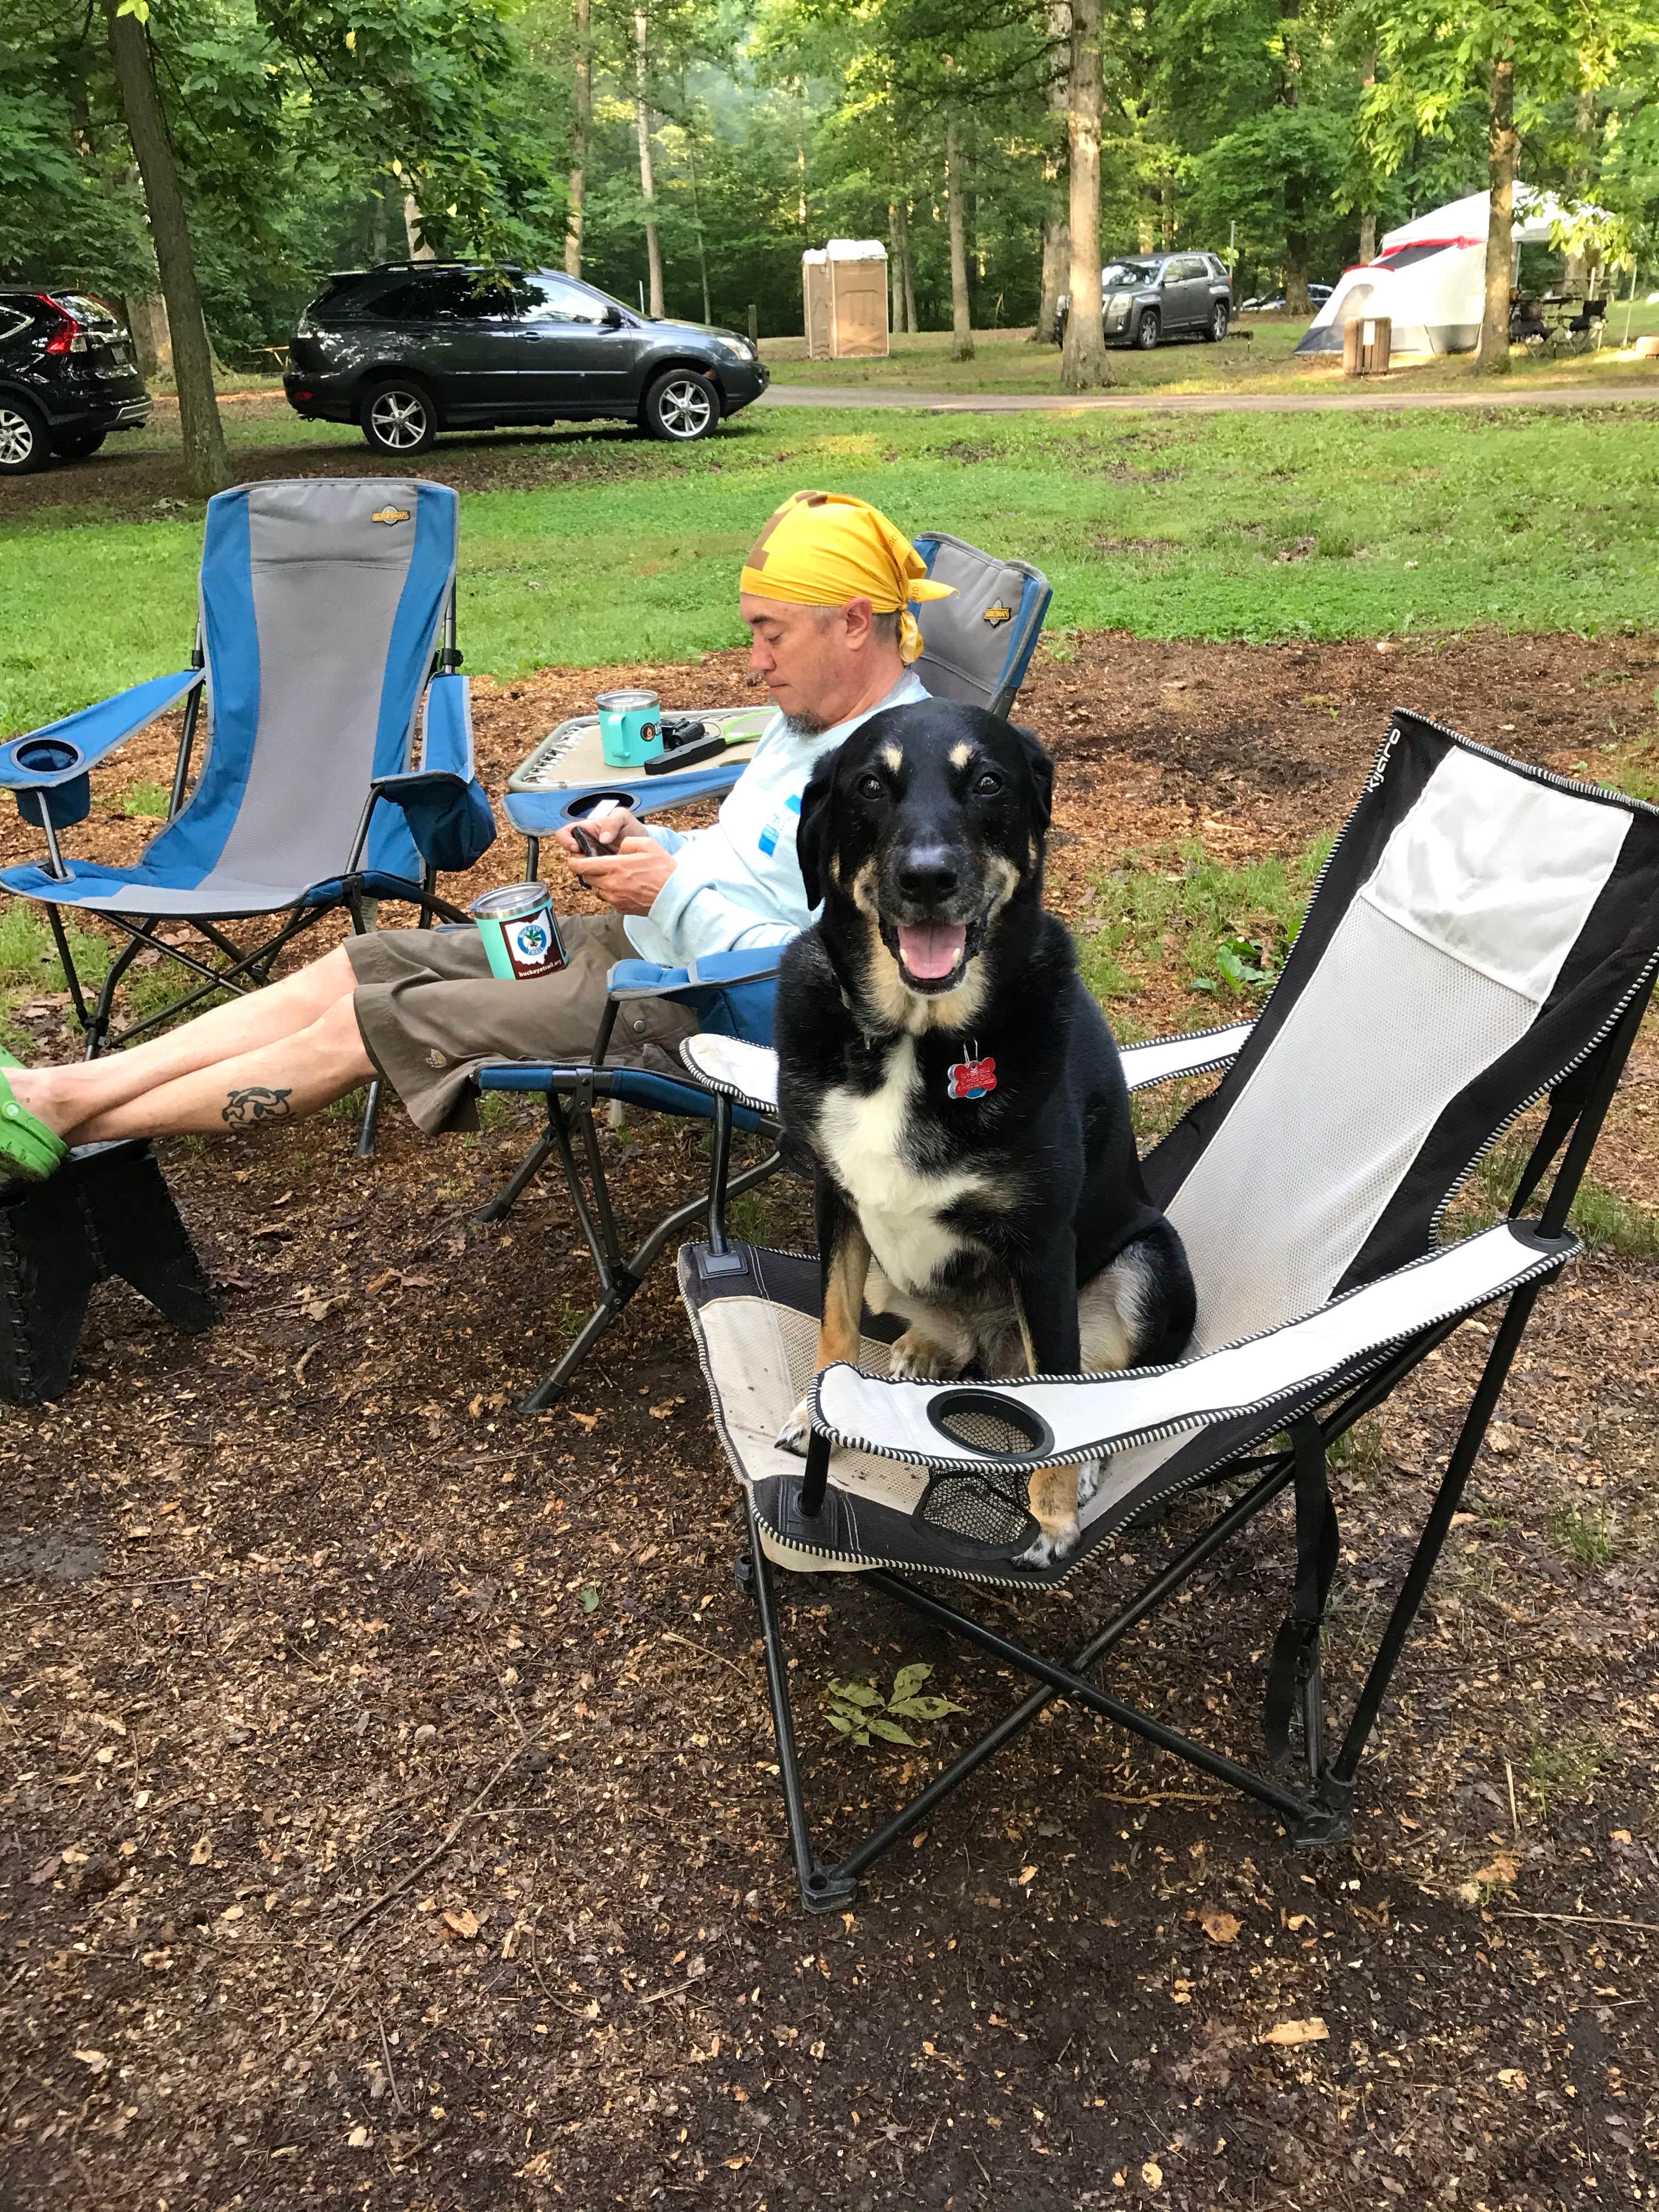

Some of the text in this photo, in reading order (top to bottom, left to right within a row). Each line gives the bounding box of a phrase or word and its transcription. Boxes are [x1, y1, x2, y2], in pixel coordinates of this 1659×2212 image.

[518, 926, 541, 938] BUCKEYE
[527, 946, 544, 955] TRAIL
[518, 959, 562, 977] buckeyetrail.org
